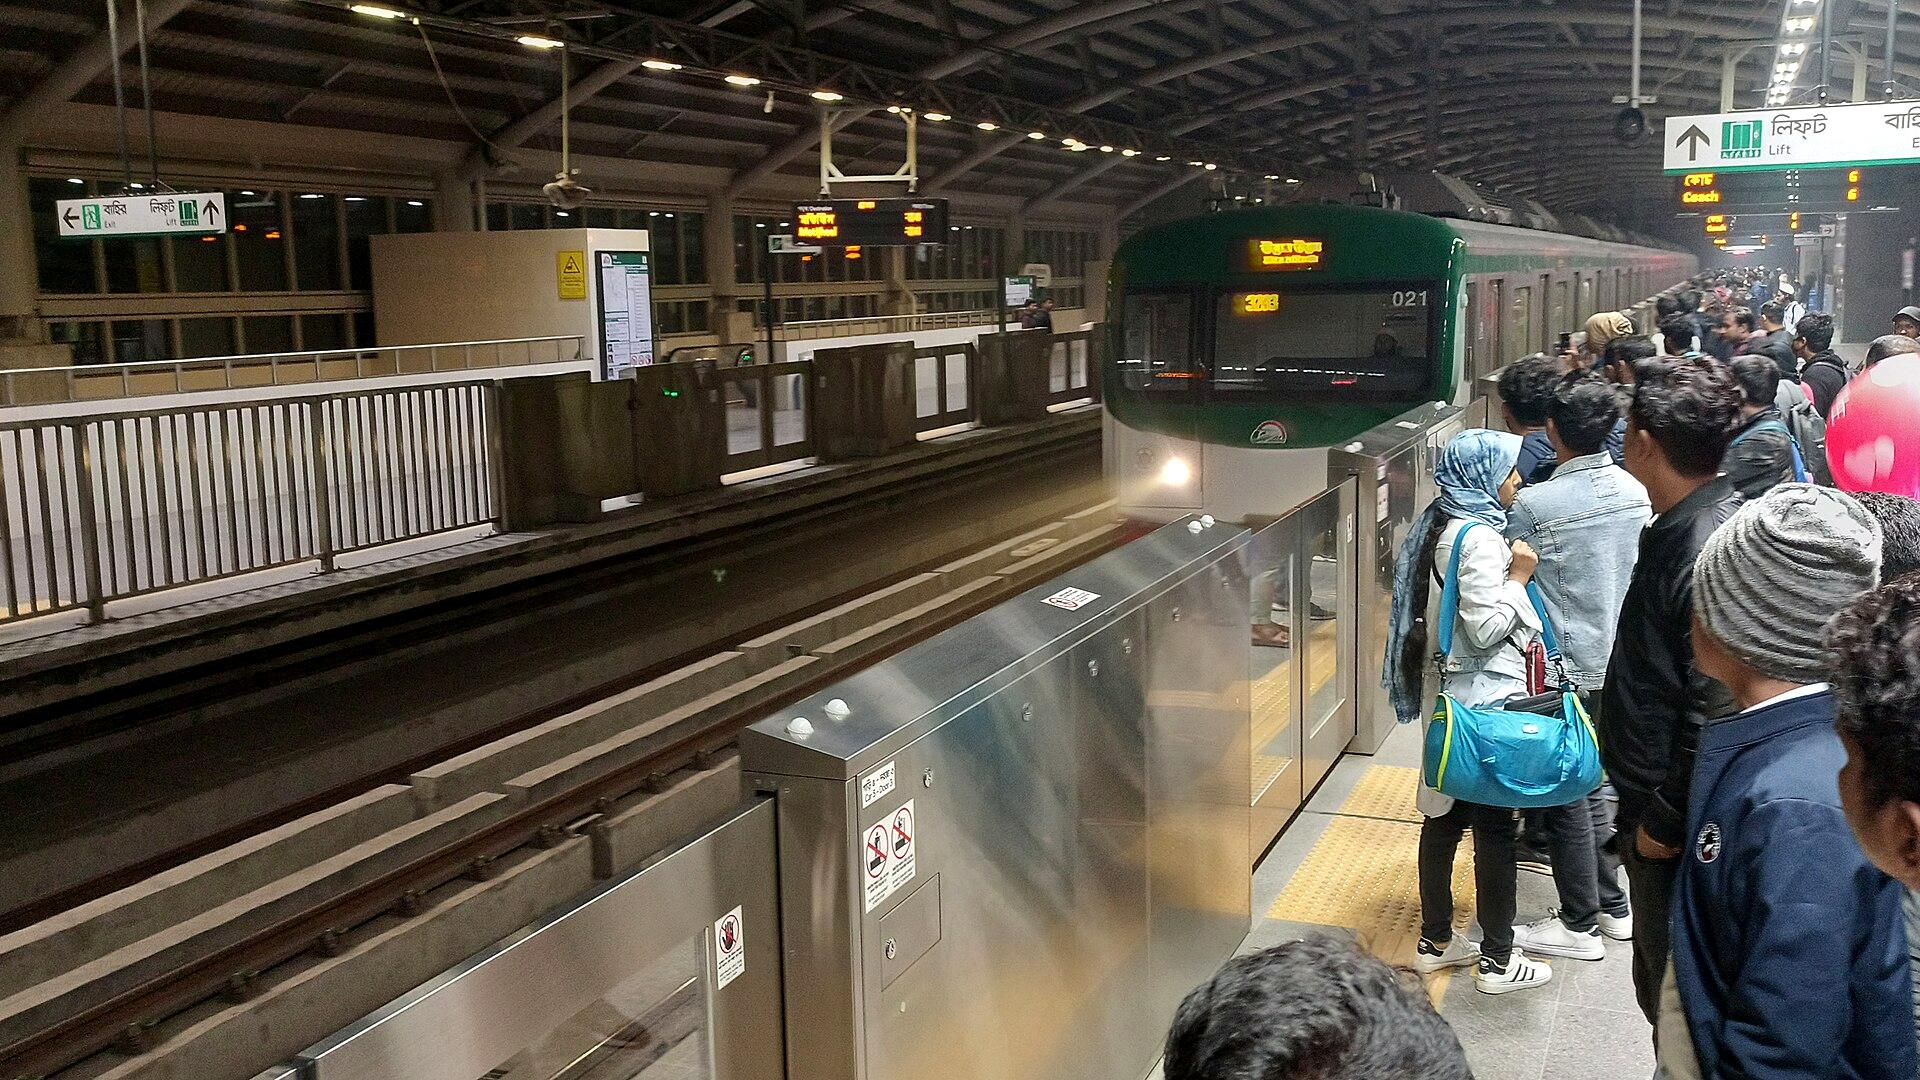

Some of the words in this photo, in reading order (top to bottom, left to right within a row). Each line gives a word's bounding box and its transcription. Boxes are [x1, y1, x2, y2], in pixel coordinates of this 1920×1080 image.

[1769, 145, 1791, 156] Lift
[1682, 190, 1719, 203] Coach
[103, 200, 127, 215] বাহির
[166, 219, 177, 227] Lift
[1392, 290, 1427, 307] 021
